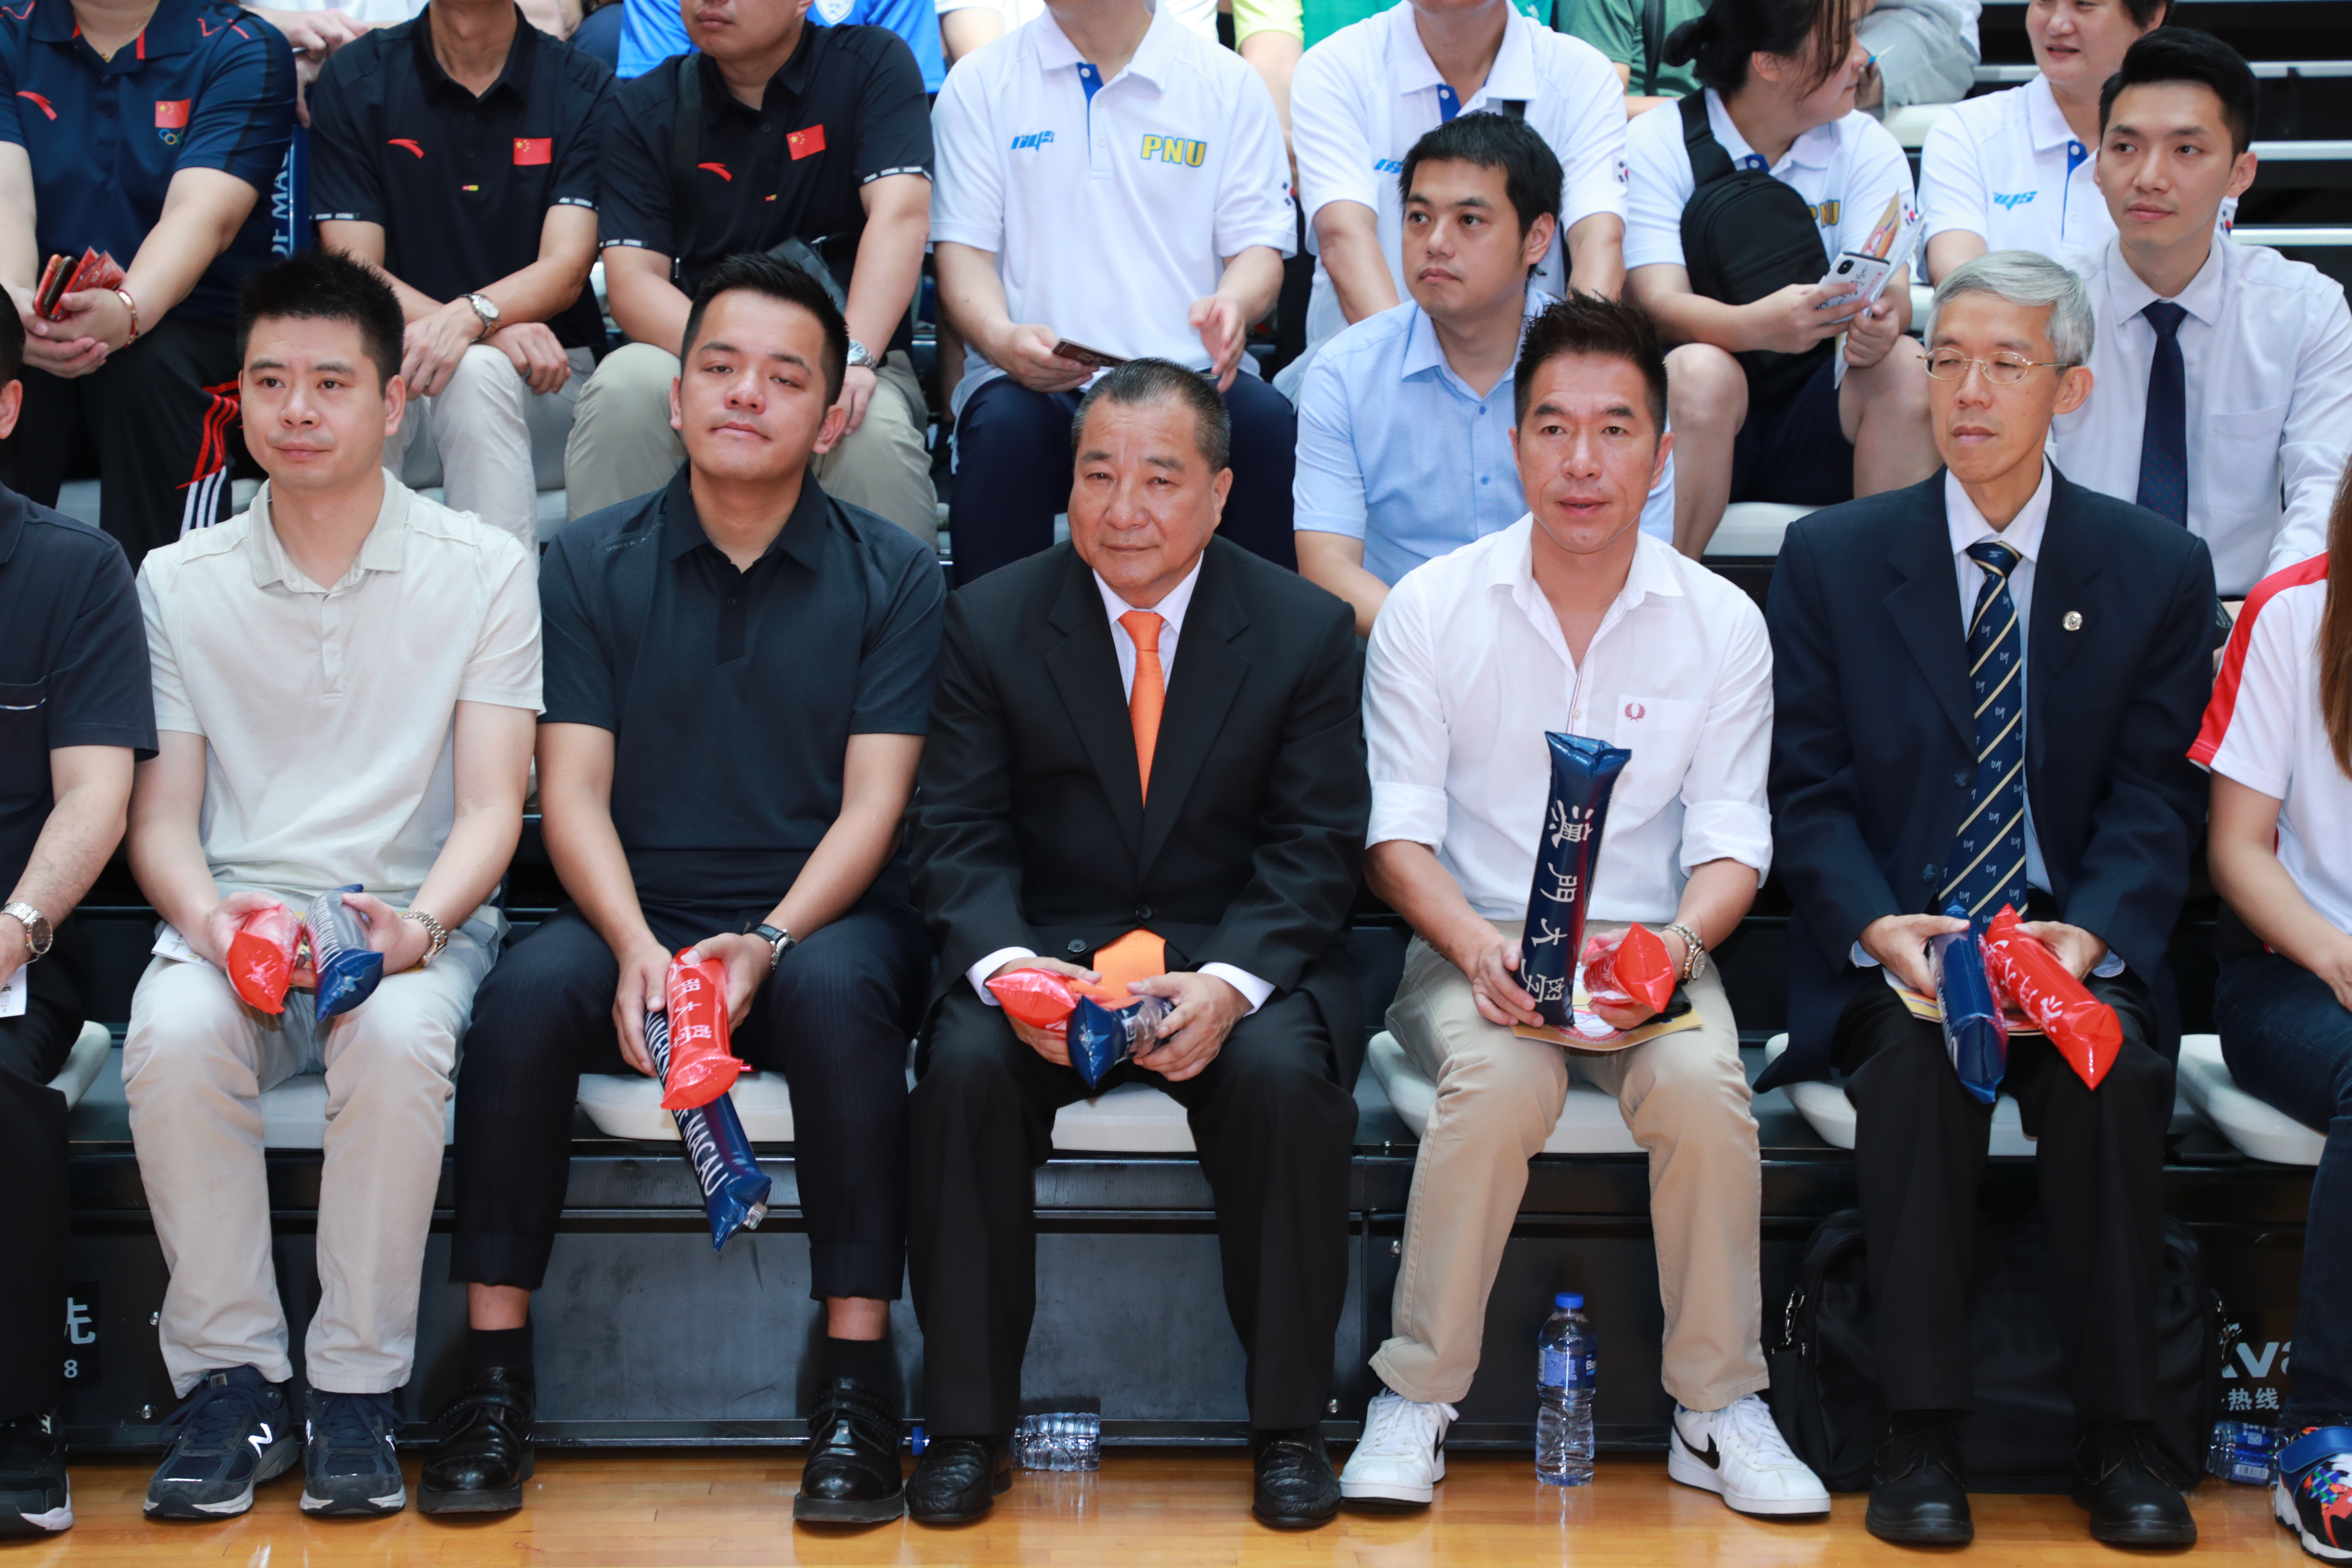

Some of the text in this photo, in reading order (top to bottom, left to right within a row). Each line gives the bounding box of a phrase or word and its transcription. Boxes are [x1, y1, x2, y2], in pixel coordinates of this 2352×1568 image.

[1141, 134, 1207, 168] PNU
[1991, 760, 2002, 772] UM
[1989, 812, 2000, 824] UM
[1963, 840, 1974, 851] UM
[2011, 837, 2021, 849] UM
[1986, 865, 1997, 876] UM
[1959, 891, 1970, 903] UM
[2009, 889, 2020, 900] UM
[1521, 799, 1594, 1003] 澳門大學
[644, 1009, 671, 1084] NIVERSI
[683, 1112, 729, 1197] MACAU
[64, 1360, 77, 1378] 8
[1586, 1360, 1597, 1371] Bo
[2221, 1387, 2280, 1411] 热线
